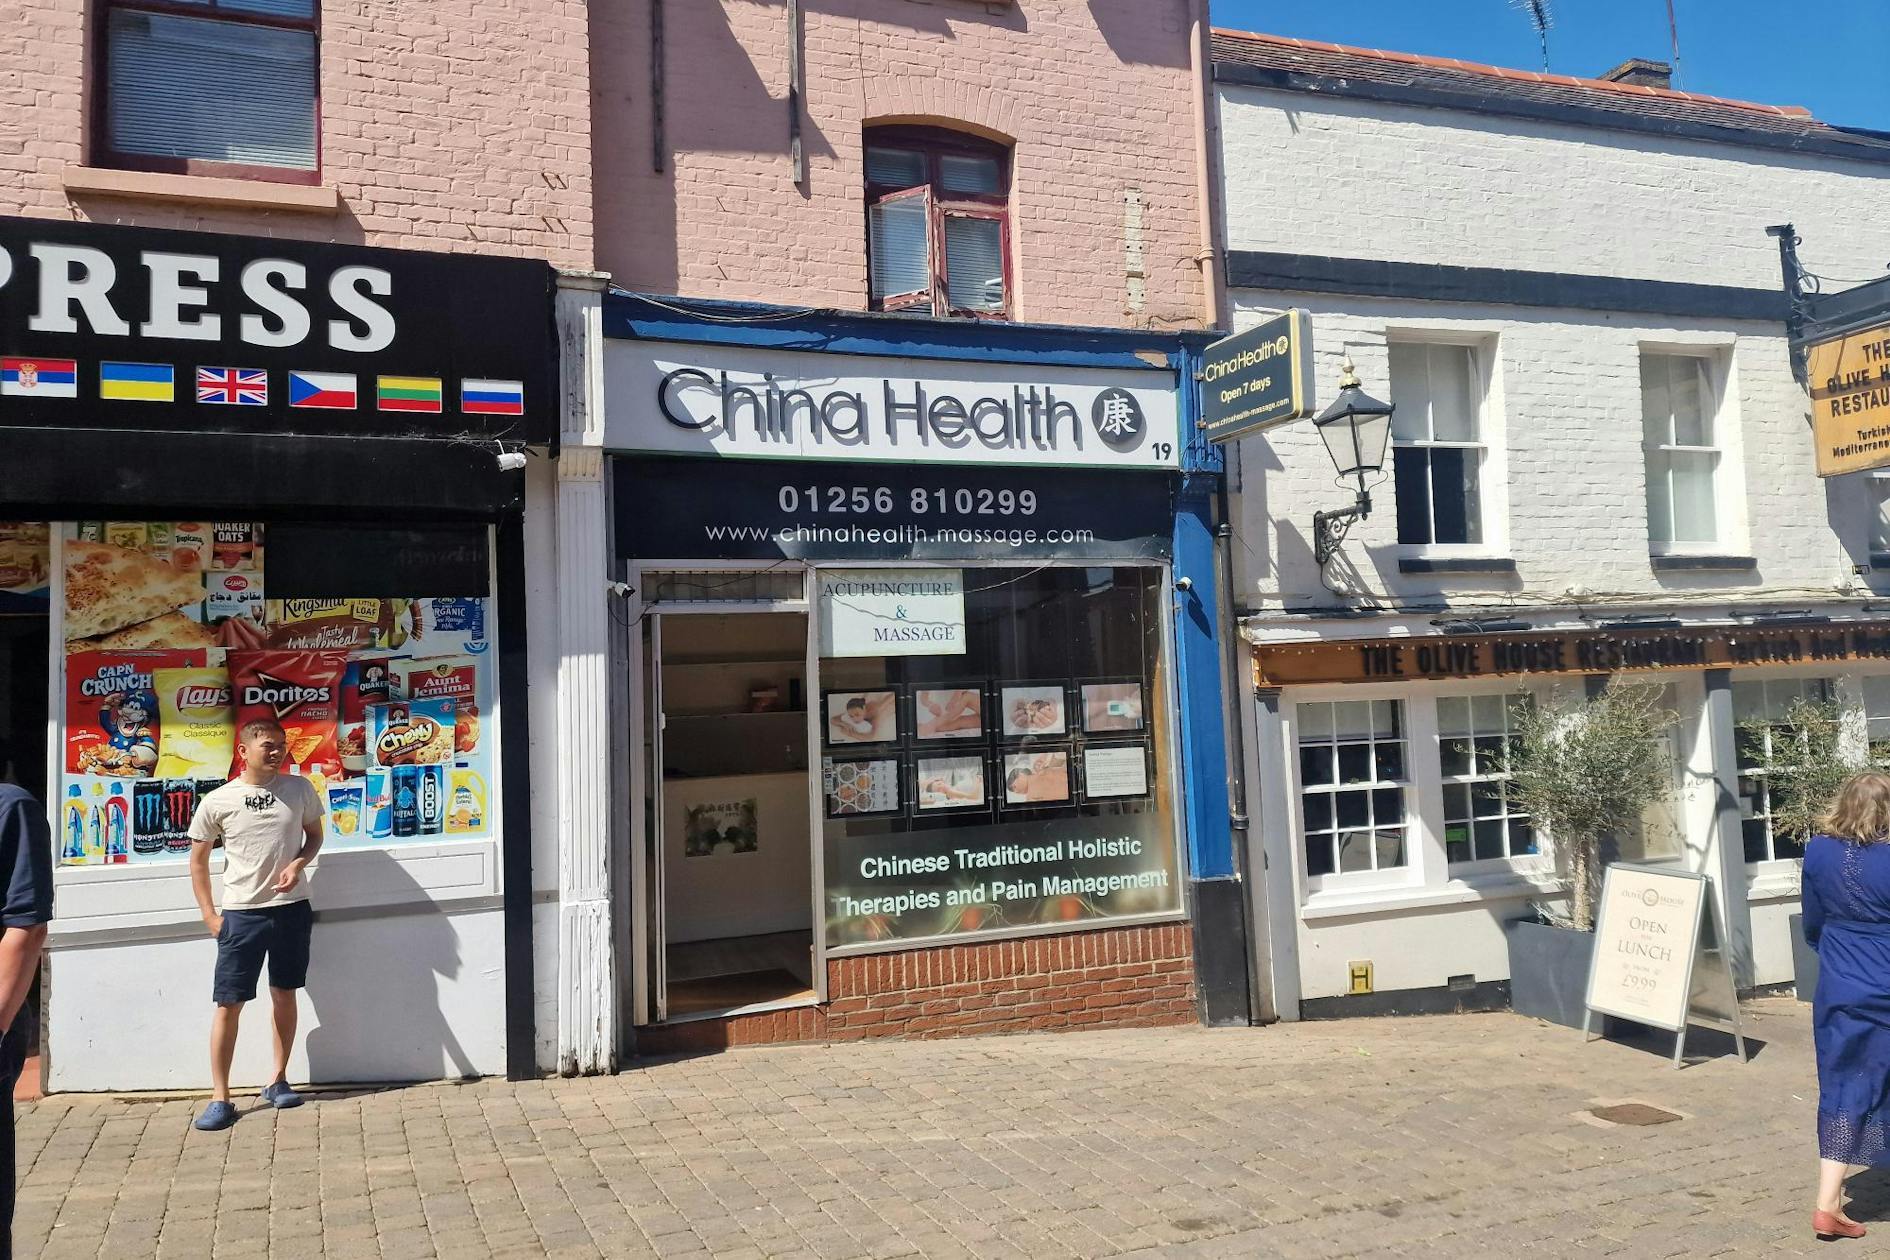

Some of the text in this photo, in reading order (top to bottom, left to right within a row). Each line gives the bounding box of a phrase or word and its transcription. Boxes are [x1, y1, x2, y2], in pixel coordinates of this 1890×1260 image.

[1205, 356, 1237, 381] China
[1237, 340, 1276, 370] Health
[1862, 338, 1890, 363] THE
[1221, 376, 1271, 403] Open 7 days
[1827, 369, 1871, 393] OLIVE
[658, 368, 1079, 441] China Health
[1098, 393, 1137, 435] 康
[1151, 442, 1172, 460] 19
[778, 485, 1037, 515] 01256 810299
[218, 532, 244, 542] OATS
[705, 523, 1094, 547] www.chinahealth.massage.com
[822, 581, 954, 597] ACUPUNCTURE
[356, 607, 377, 616] LOAF
[896, 604, 907, 619] &
[320, 623, 345, 639] Tasty
[874, 626, 956, 642] MASSAGE
[1361, 644, 1404, 676] THE
[1416, 642, 1480, 674] OLIVE
[81, 674, 152, 697] CRUNCH
[360, 680, 389, 691] QUAKER
[424, 674, 461, 688] Aunt
[245, 686, 330, 705] Doritos
[183, 730, 227, 739] Classique
[189, 721, 222, 729] Classic
[380, 722, 434, 752] Chewy
[424, 776, 436, 818] BOOST
[860, 836, 1142, 880] Chinese Traditional Holistic
[832, 868, 1169, 918] Therapies and Pain Management
[1629, 916, 1668, 935] OPEN
[1618, 939, 1673, 962] LUNCH
[1351, 967, 1369, 991] H
[1622, 973, 1657, 992] £9.99
